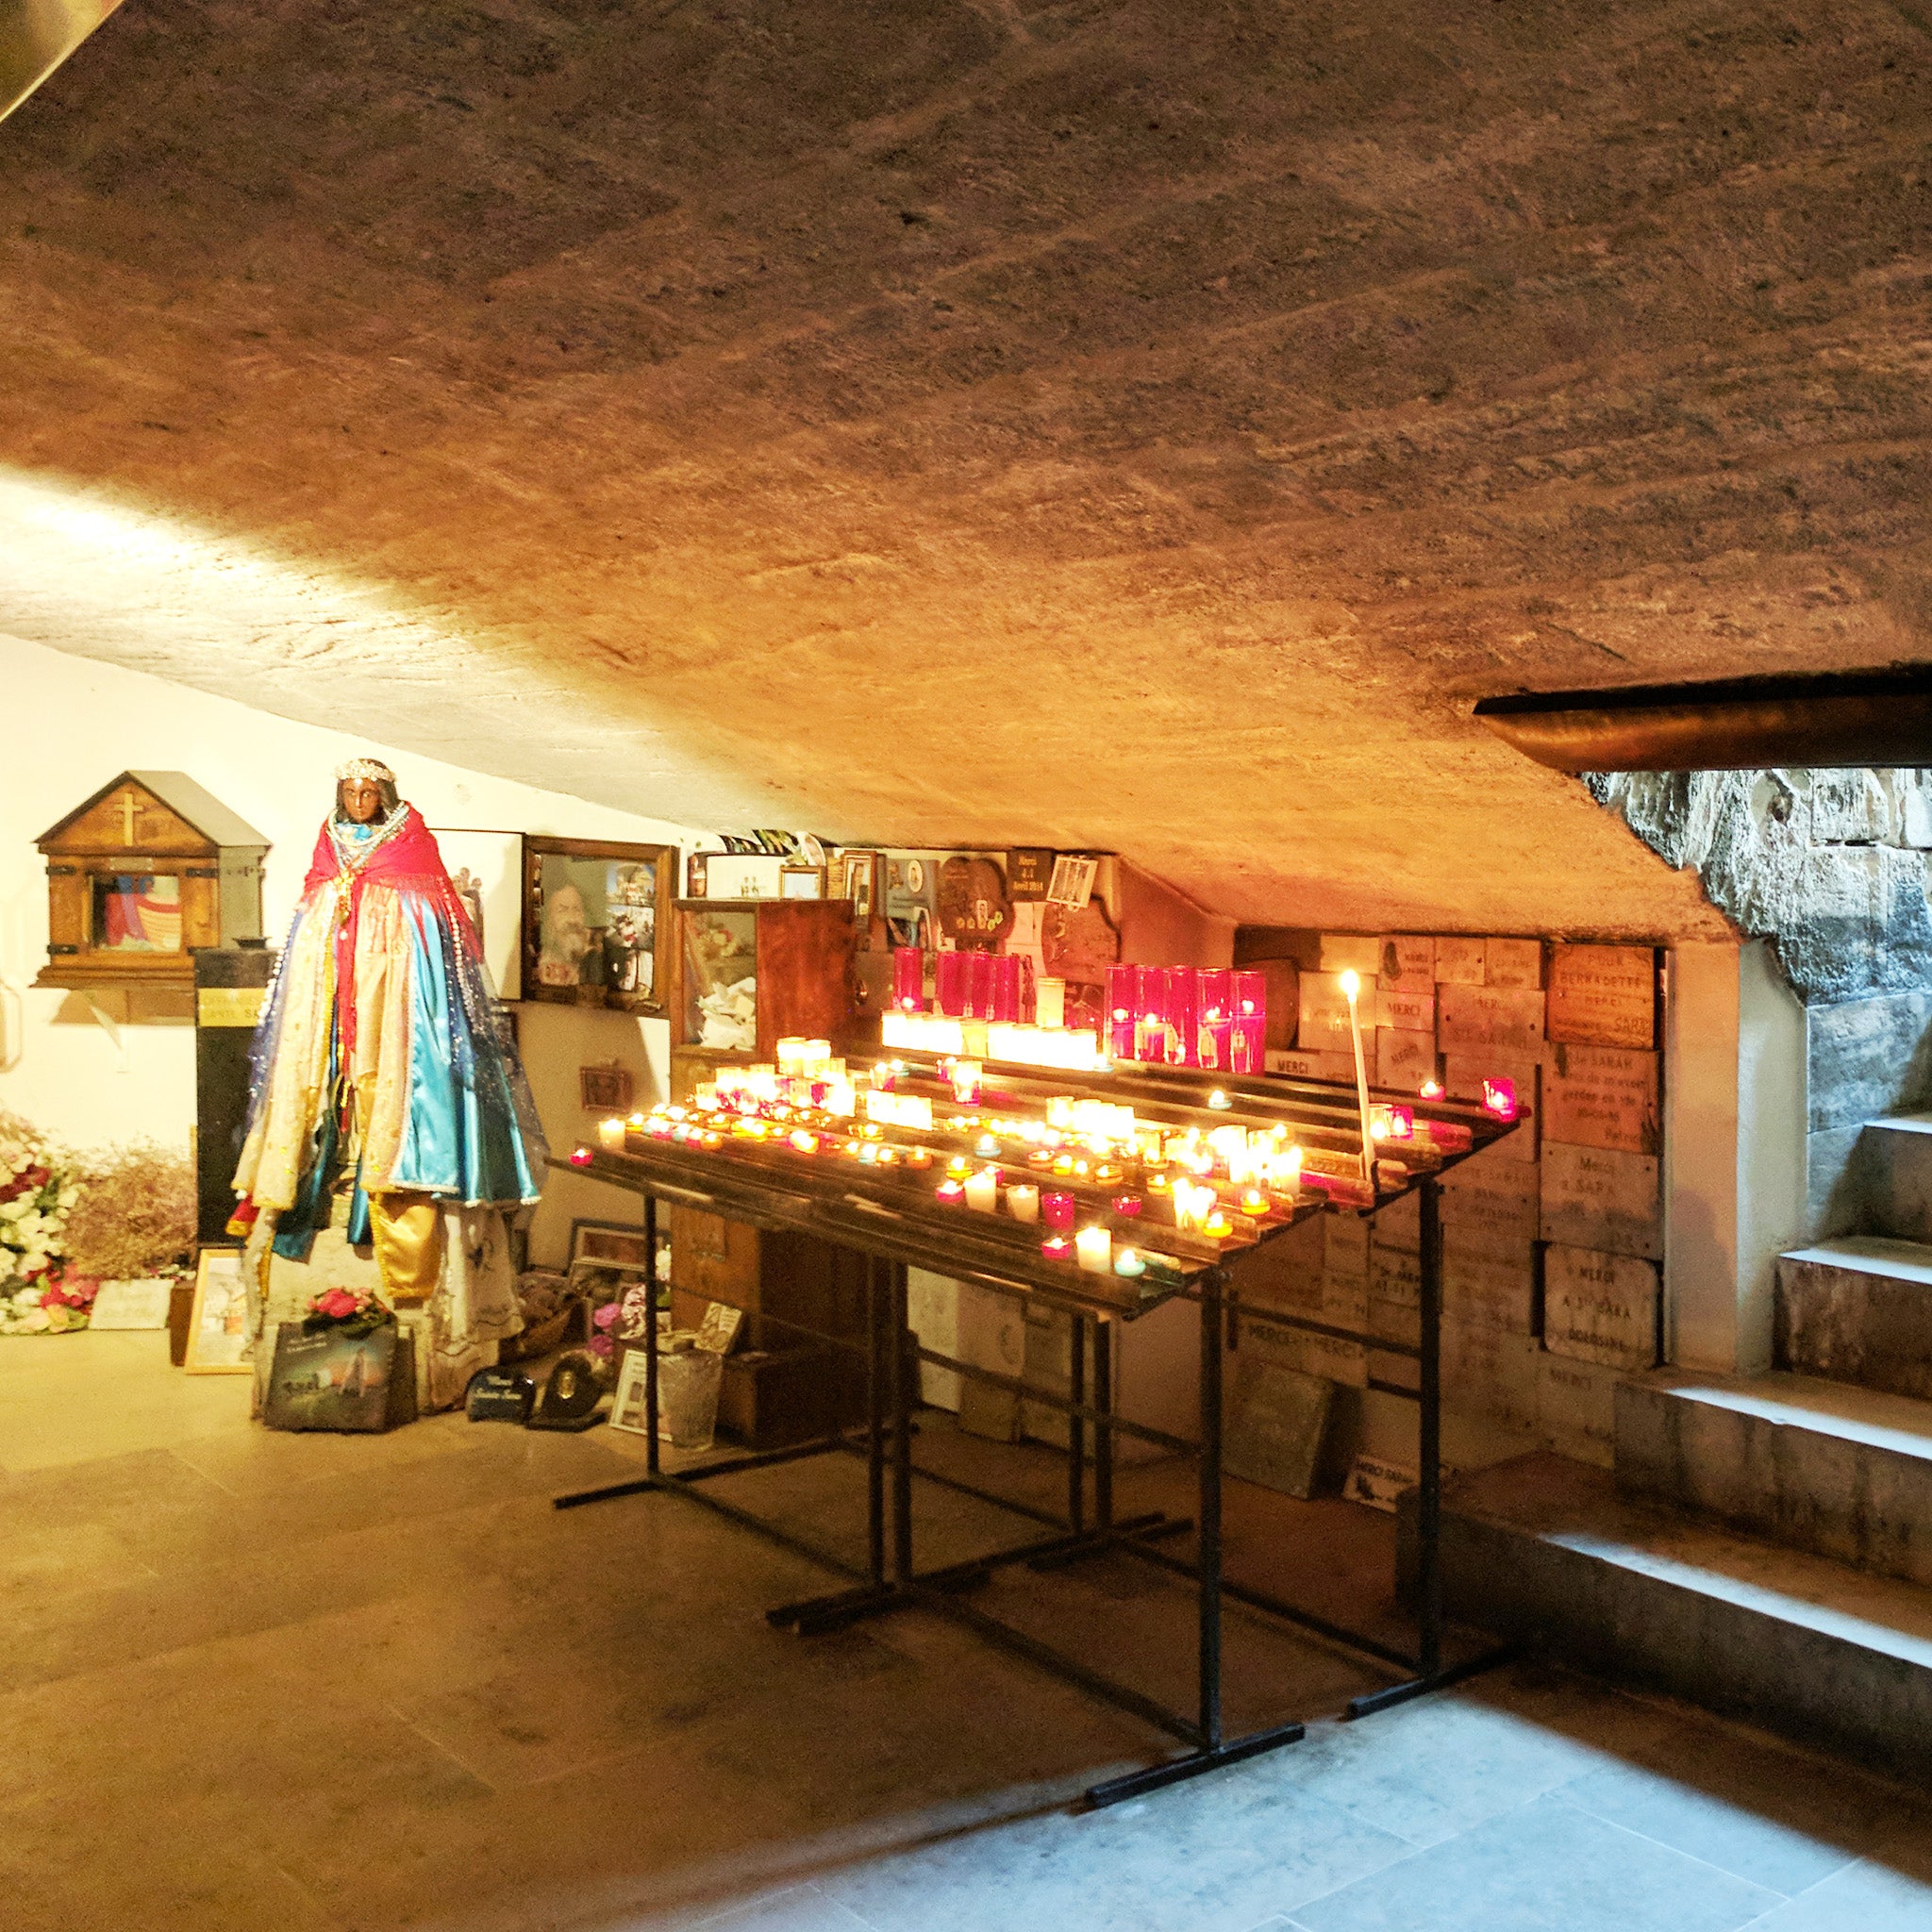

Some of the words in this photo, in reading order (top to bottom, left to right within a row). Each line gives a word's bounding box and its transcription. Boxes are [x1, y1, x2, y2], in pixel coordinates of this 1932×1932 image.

[1560, 971, 1641, 989] BERNADETTE
[1388, 1002, 1420, 1017] MERCI
[1277, 1058, 1308, 1074] MERCI
